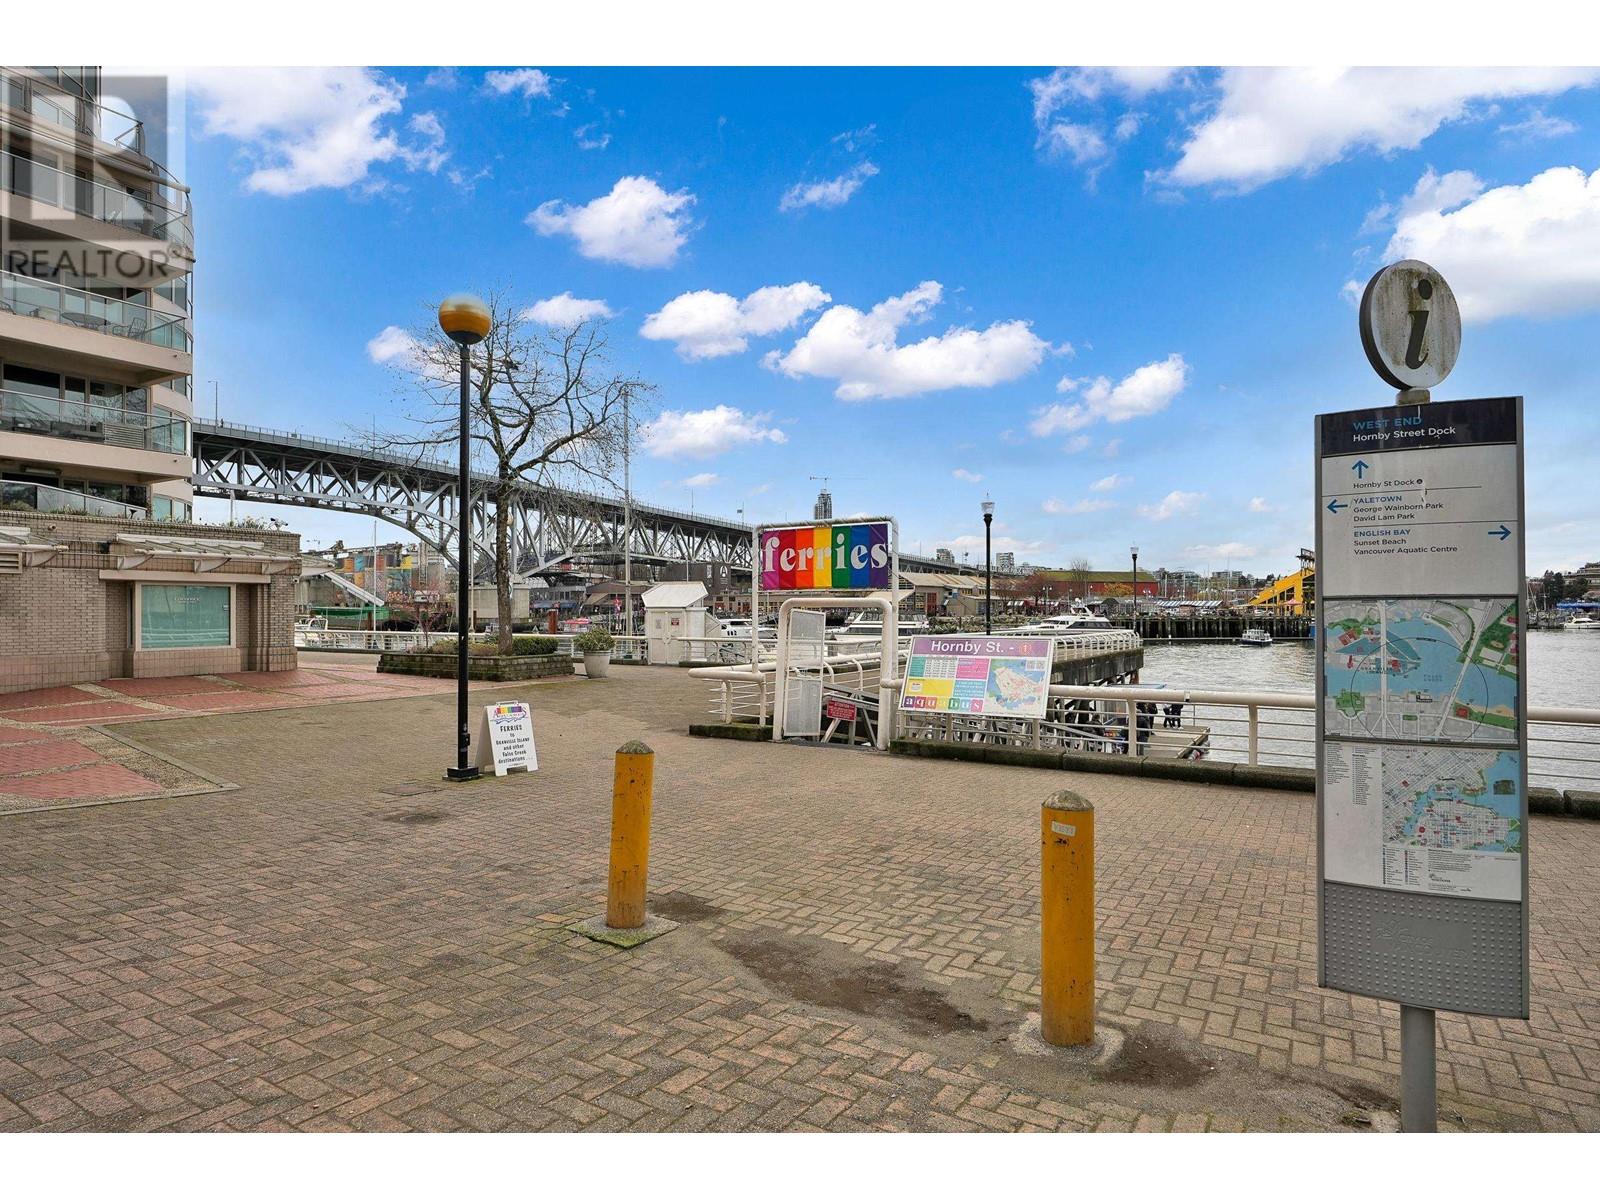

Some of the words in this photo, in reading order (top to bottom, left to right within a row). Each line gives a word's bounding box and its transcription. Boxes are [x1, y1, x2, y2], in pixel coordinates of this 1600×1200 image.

[1353, 419, 1388, 431] WEST
[1394, 417, 1422, 427] END
[1353, 431, 1390, 443] Hornby
[1393, 428, 1425, 439] Street
[1428, 426, 1456, 436] Dock
[1353, 480, 1382, 489] Hornby
[1383, 480, 1393, 488] St
[1394, 479, 1415, 487] Dock
[1353, 495, 1403, 504] YALETOWN
[1384, 503, 1424, 512] Wainborn
[1425, 502, 1444, 510] Park
[1353, 514, 1376, 522] David
[1396, 512, 1415, 520] Park
[1353, 529, 1391, 538] ENGLISH
[1393, 528, 1411, 537] BAY
[1353, 539, 1380, 547] Sunset
[1381, 538, 1407, 546] Beach
[762, 532, 888, 572] ferries
[1354, 547, 1395, 555] Vancouver
[1397, 546, 1428, 555] Aquatic
[1430, 545, 1458, 553] Centre
[931, 640, 981, 655] Hornby
[986, 641, 1005, 653] St.
